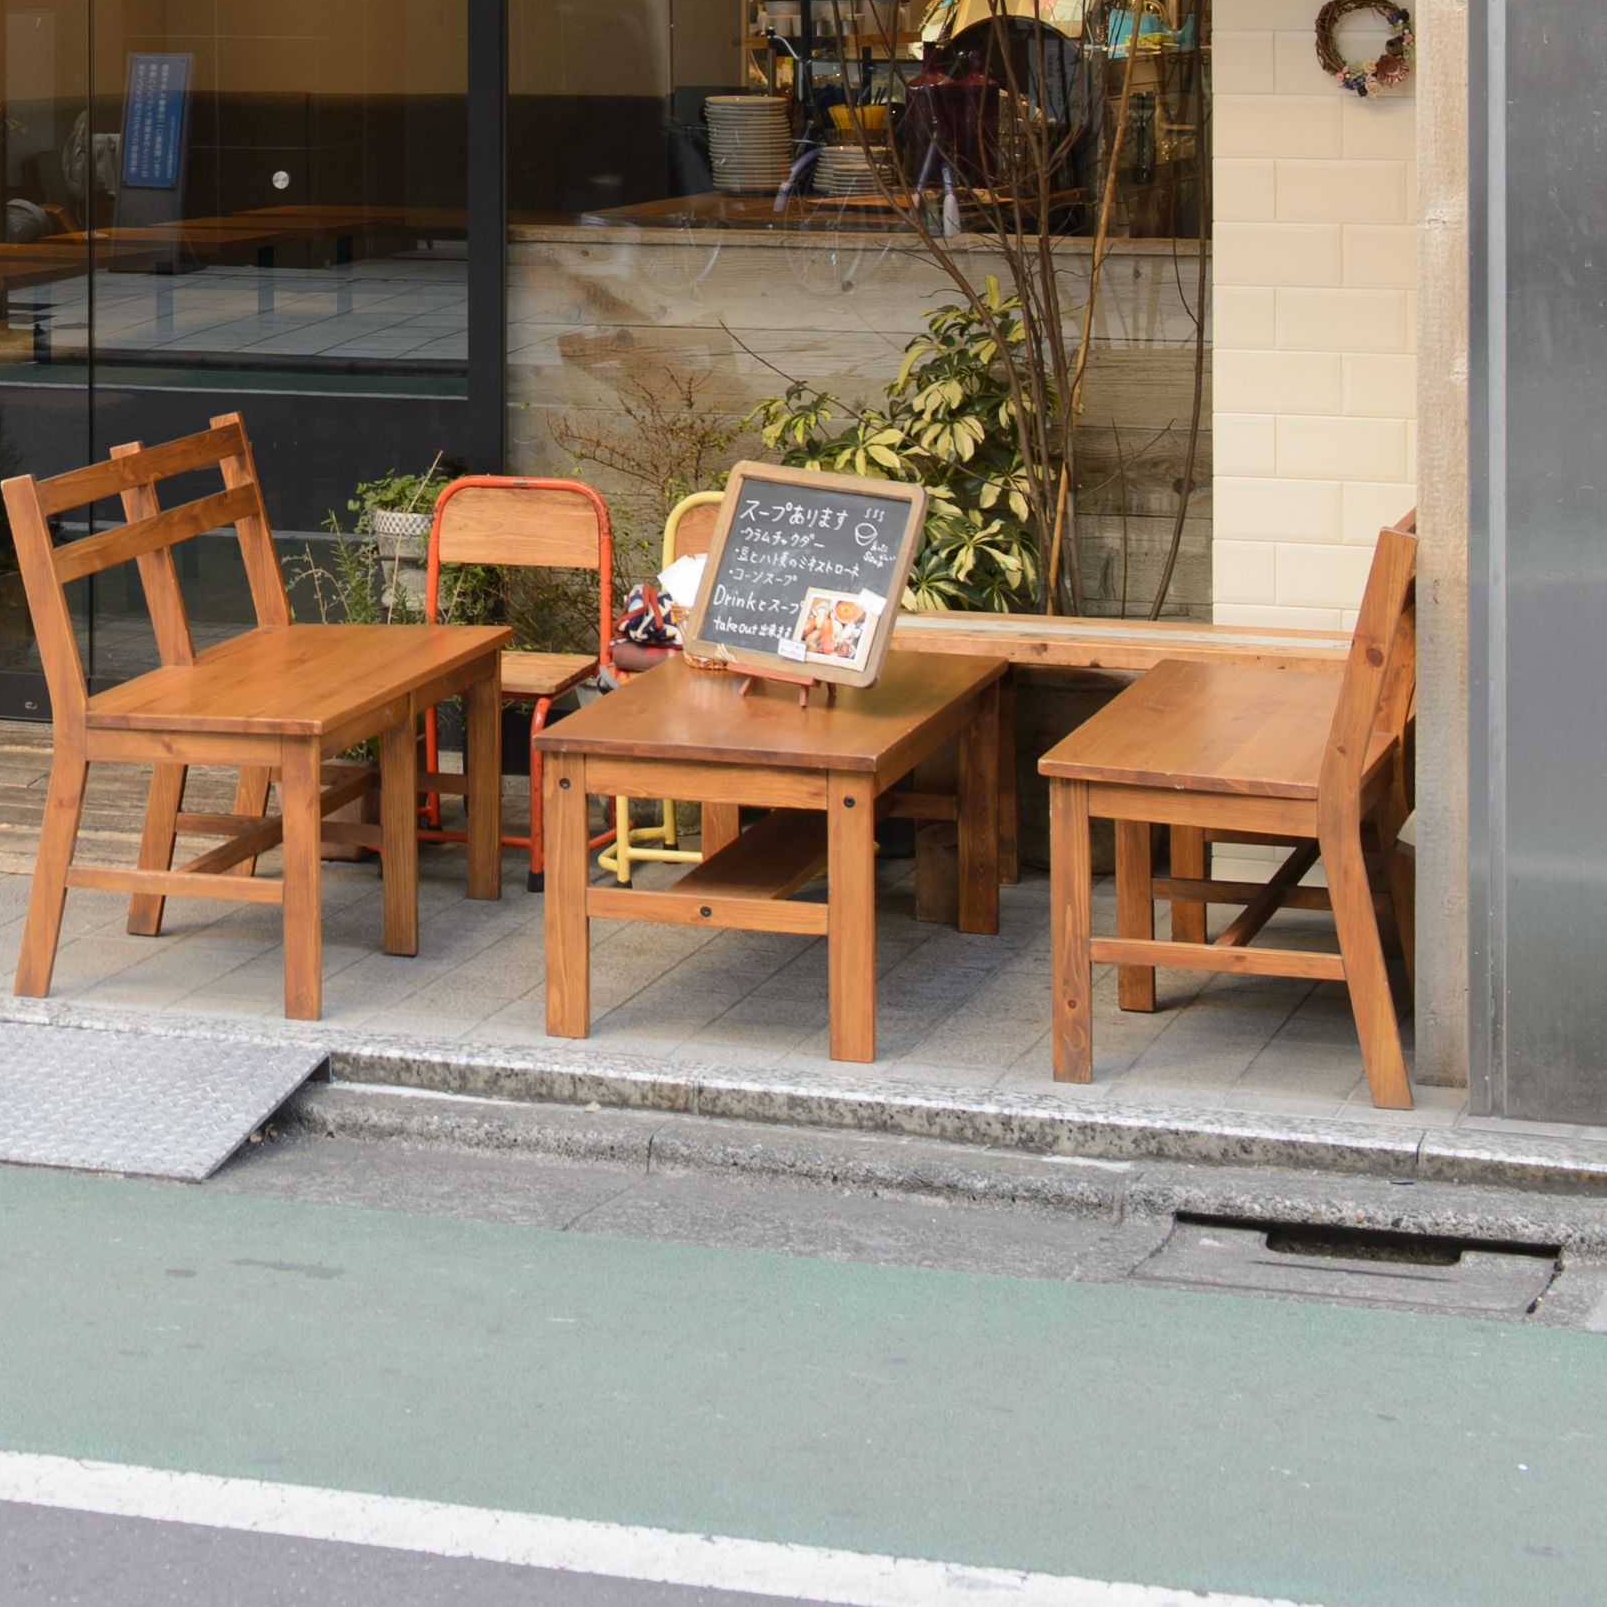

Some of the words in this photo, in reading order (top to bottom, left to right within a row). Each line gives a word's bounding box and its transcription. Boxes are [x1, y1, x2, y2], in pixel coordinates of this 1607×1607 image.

[739, 500, 849, 531] スープあります
